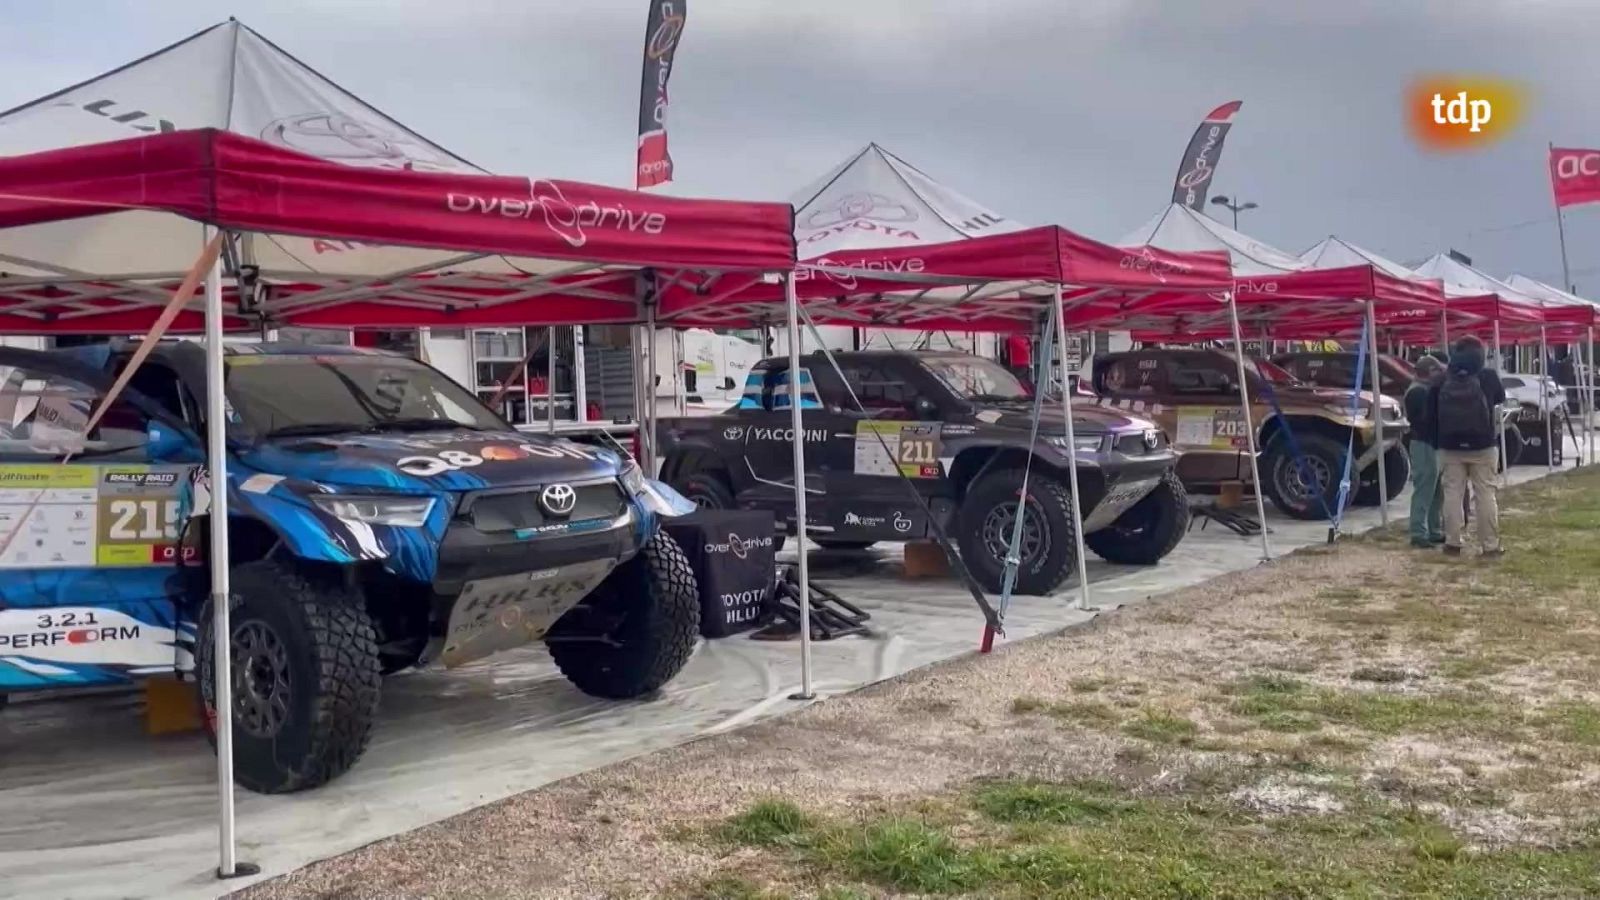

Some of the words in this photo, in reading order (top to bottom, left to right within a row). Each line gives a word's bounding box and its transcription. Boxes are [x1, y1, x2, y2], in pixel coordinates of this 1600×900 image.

[901, 441, 936, 463] 211
[396, 451, 484, 477] Q8
[37, 612, 99, 629] 3.2.1
